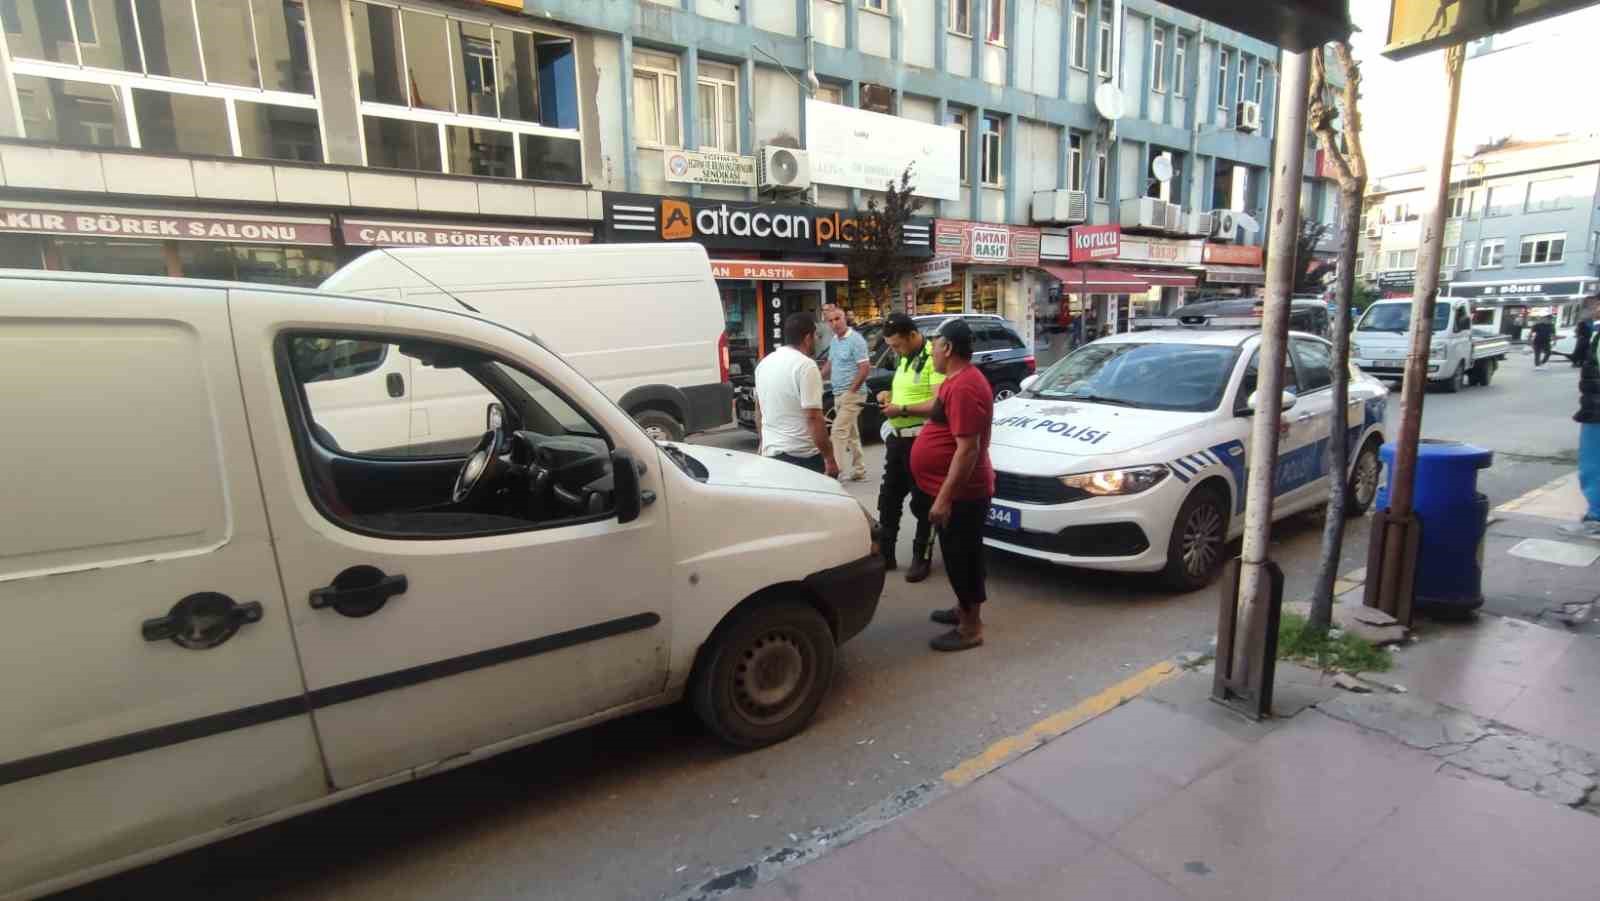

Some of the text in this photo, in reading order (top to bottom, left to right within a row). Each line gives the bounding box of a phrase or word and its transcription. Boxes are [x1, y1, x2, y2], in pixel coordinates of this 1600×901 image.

[76, 215, 179, 235] BÖREK
[188, 223, 297, 241] SALONU
[696, 204, 810, 239] atacan
[435, 231, 502, 247] BÖREK
[1075, 230, 1117, 249] korucu
[712, 266, 795, 278] AN PLASTİK
[1032, 419, 1112, 445] POLİSİ
[989, 508, 1012, 524] 344
